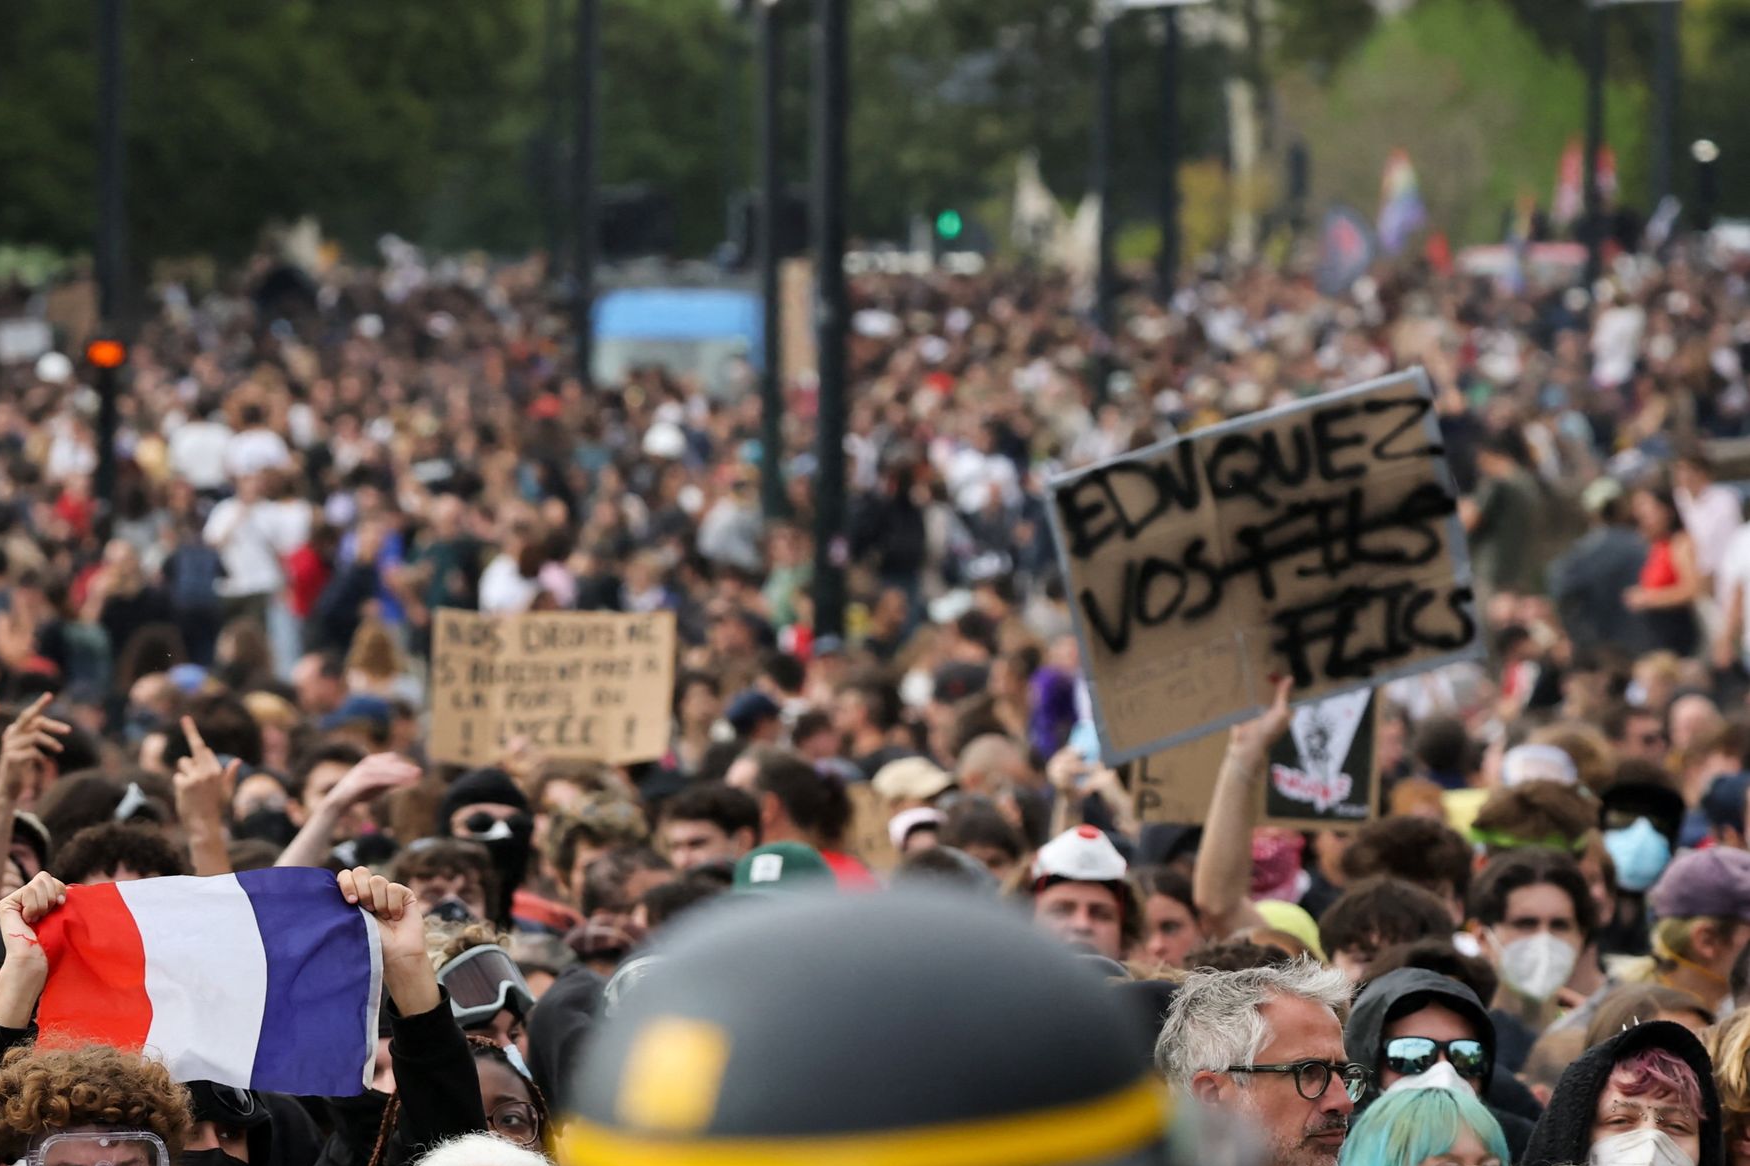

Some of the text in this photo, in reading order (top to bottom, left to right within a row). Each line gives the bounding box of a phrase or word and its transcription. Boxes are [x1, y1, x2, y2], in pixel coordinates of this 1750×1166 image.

[1079, 537, 1226, 655] VOS
[444, 619, 505, 653] NOS
[520, 619, 617, 653] DROITS
[1272, 580, 1477, 689] FLICS
[450, 689, 489, 710] LA
